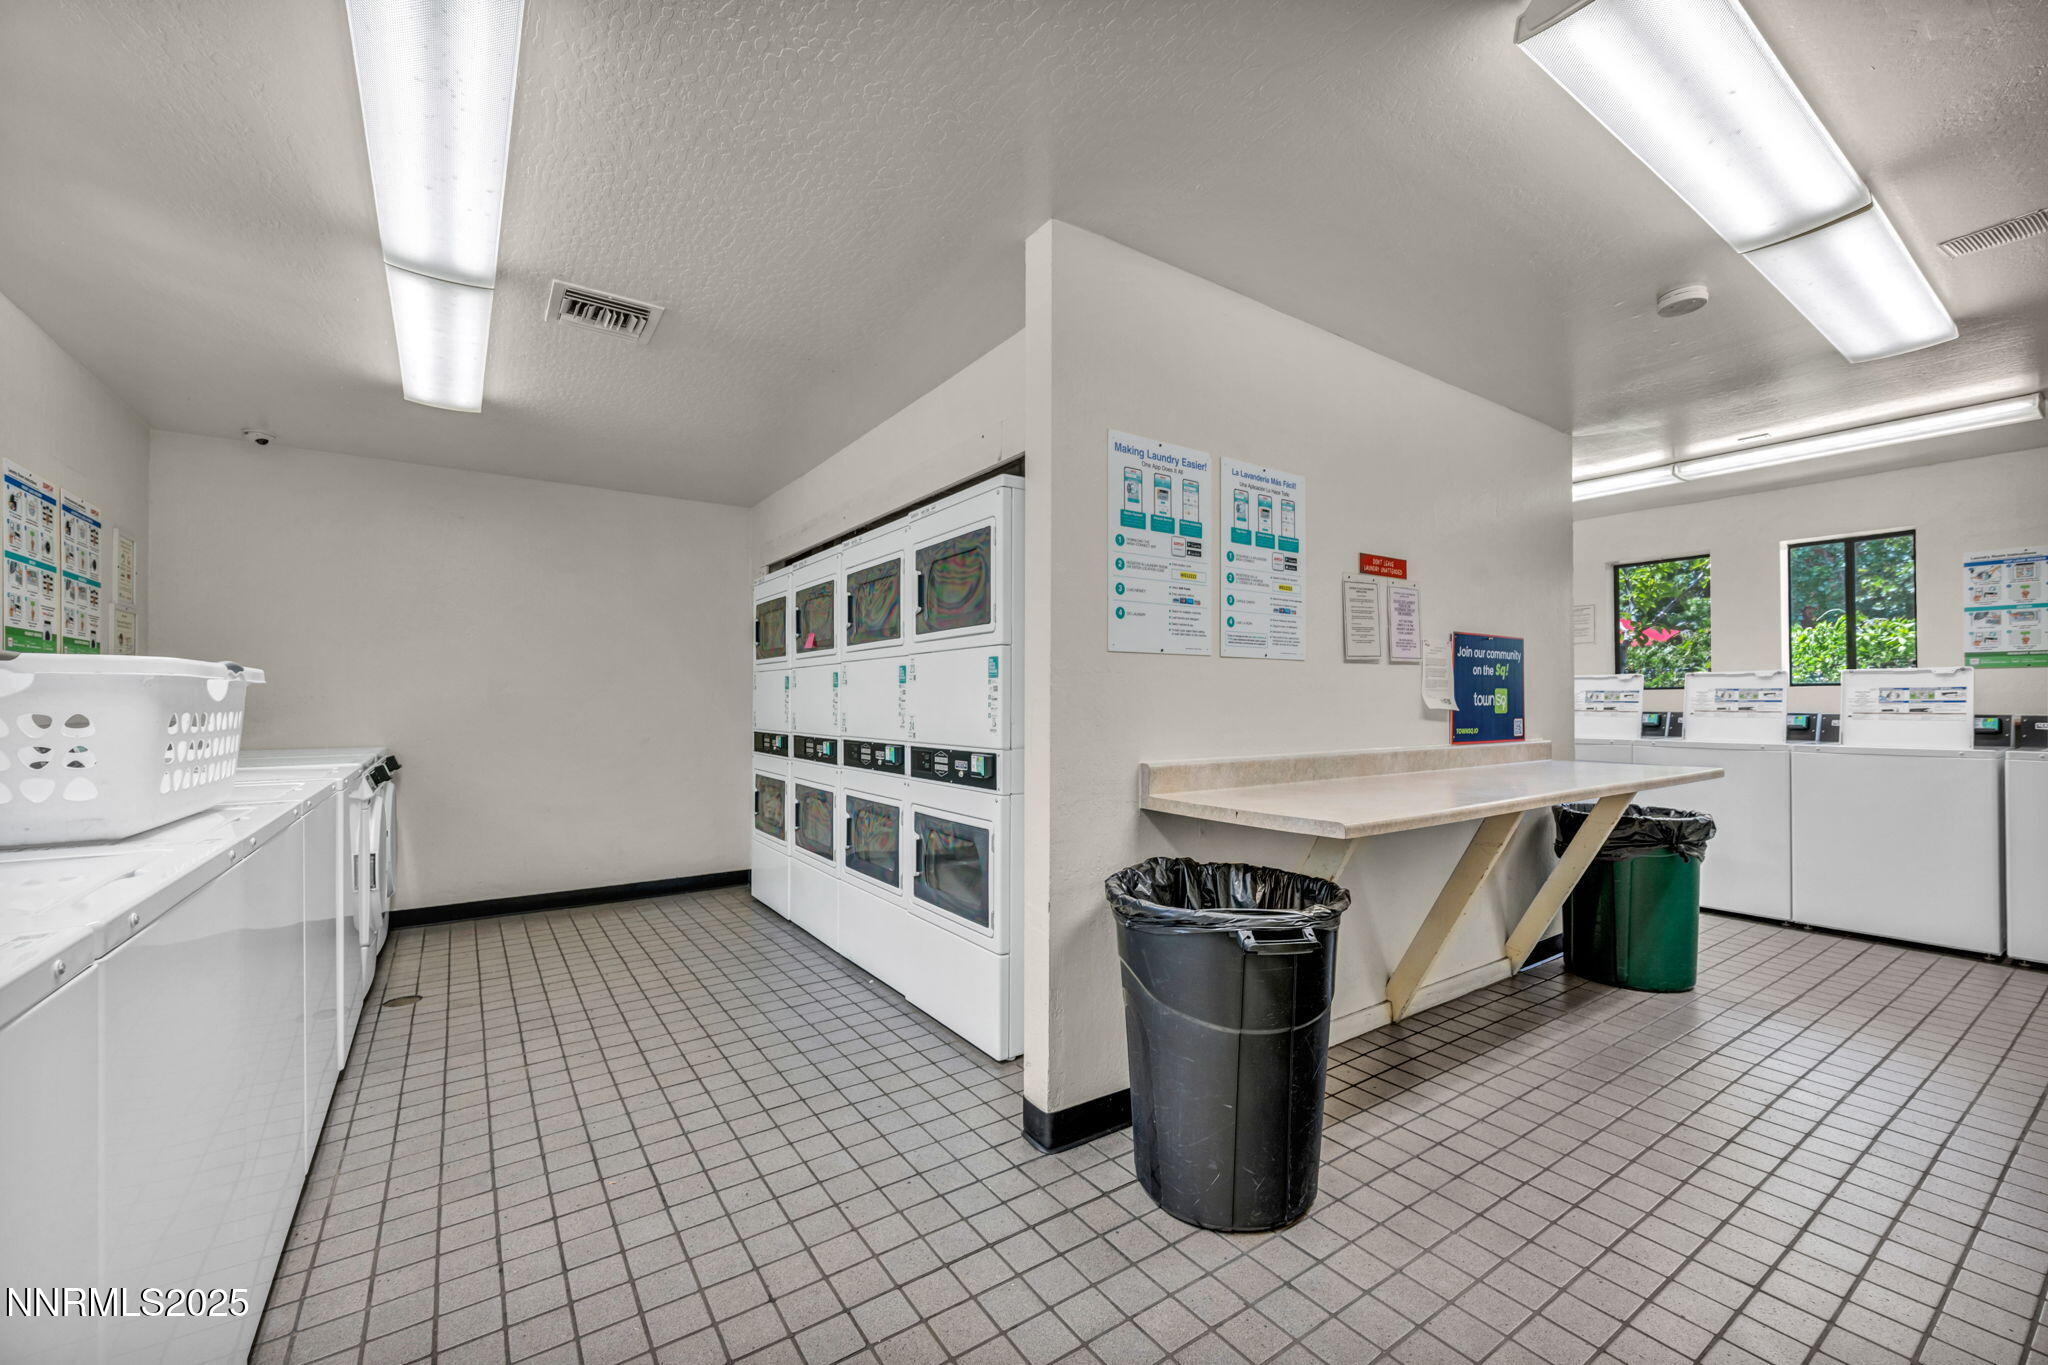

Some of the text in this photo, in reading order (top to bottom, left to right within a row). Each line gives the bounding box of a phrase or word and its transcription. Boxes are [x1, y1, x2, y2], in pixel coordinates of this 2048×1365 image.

[1114, 441, 1207, 472] Making Laundry Easier!
[1152, 463, 1162, 471] App
[1231, 468, 1239, 476] La
[1457, 645, 1521, 663] Join our community
[1472, 663, 1509, 679] on the Sq!
